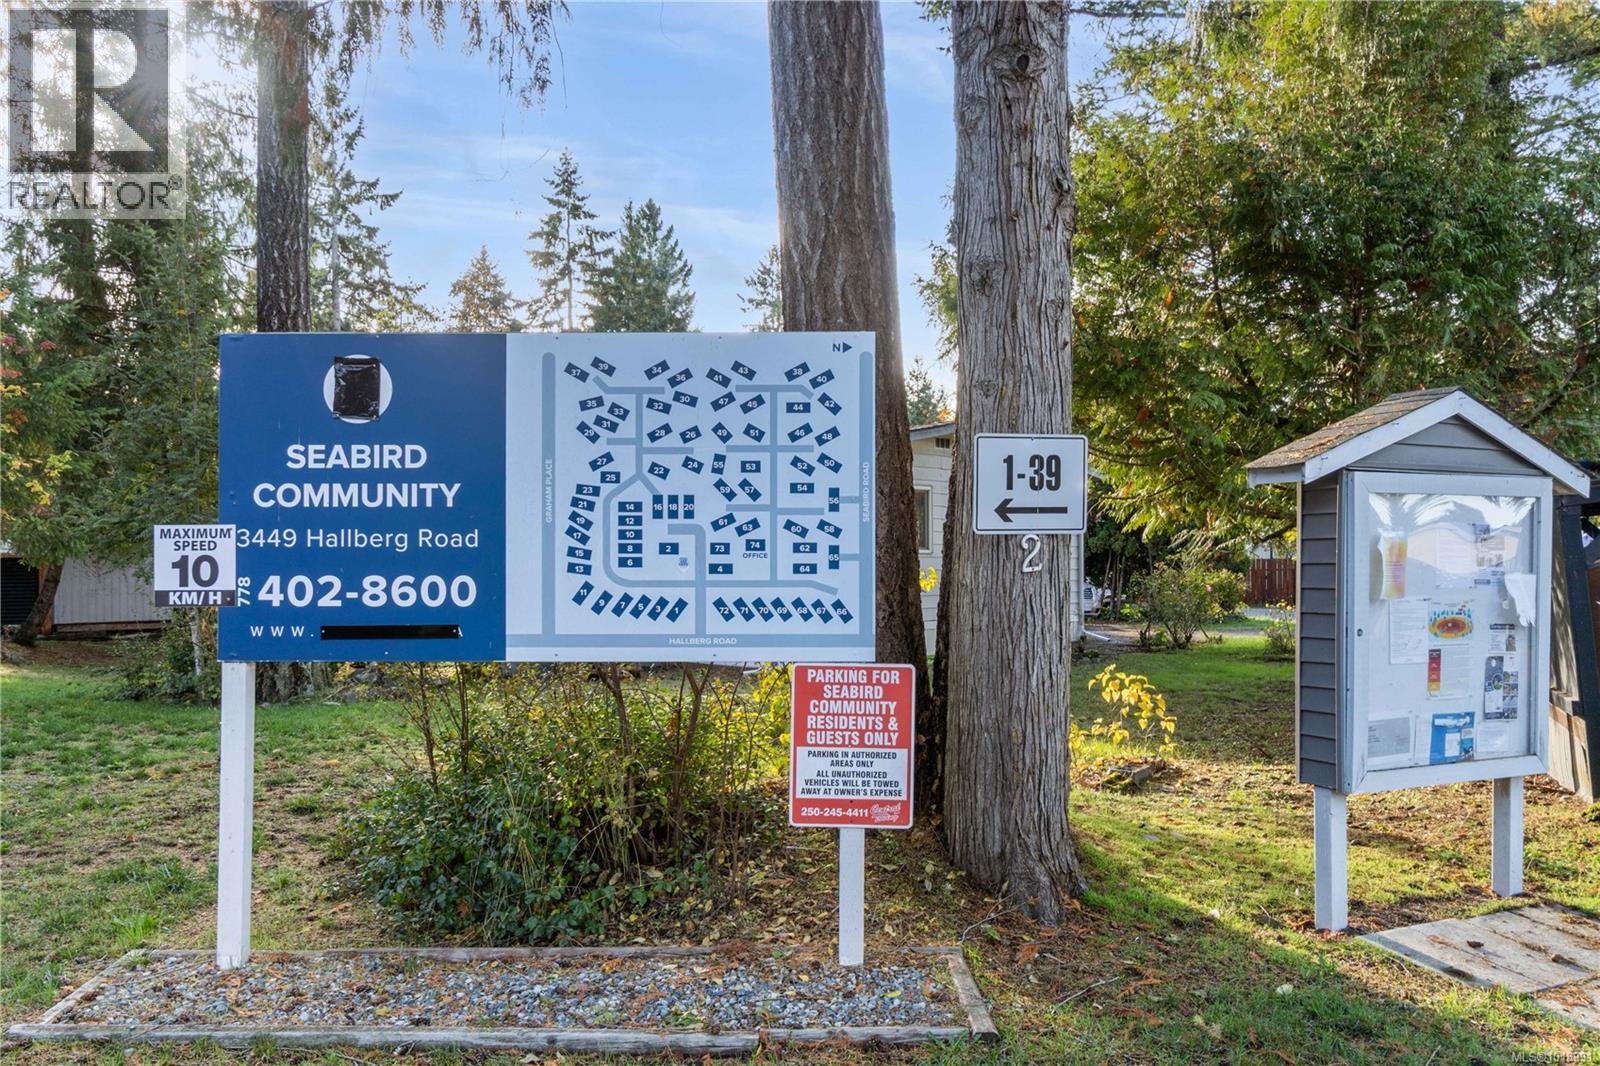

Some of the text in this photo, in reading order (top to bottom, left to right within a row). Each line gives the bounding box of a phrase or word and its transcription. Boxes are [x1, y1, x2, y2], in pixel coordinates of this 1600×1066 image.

[832, 344, 840, 352] N
[286, 444, 428, 470] SEABIRD
[1003, 454, 1062, 492] 1-39
[253, 482, 462, 508] COMMUNITY
[159, 528, 232, 540] MAXIMUM
[237, 528, 480, 552] 3449 Hallberg Road
[174, 540, 217, 552] SPEED
[1021, 534, 1042, 573] 2
[171, 554, 220, 588] 10
[238, 576, 251, 607] 778
[258, 574, 477, 608] 402-8600
[668, 637, 737, 645] HALLBERG ROAD
[808, 669, 900, 684] PARKING FOR
[824, 685, 884, 700] SEABIRD
[810, 700, 897, 715] COMMUNITY
[807, 716, 898, 731] RESIDENTS &
[806, 731, 900, 746] GUESTS ONLY
[808, 750, 897, 760] PARKING IN AUTHORIZED
[832, 770, 887, 779] UNAUTHORIZED
[804, 779, 839, 787] VEHICLES
[874, 780, 899, 788] TOWED
[834, 788, 868, 796] OWNER'S
[870, 789, 902, 797] EXPENSE
[801, 807, 868, 817] 250-245-4411
